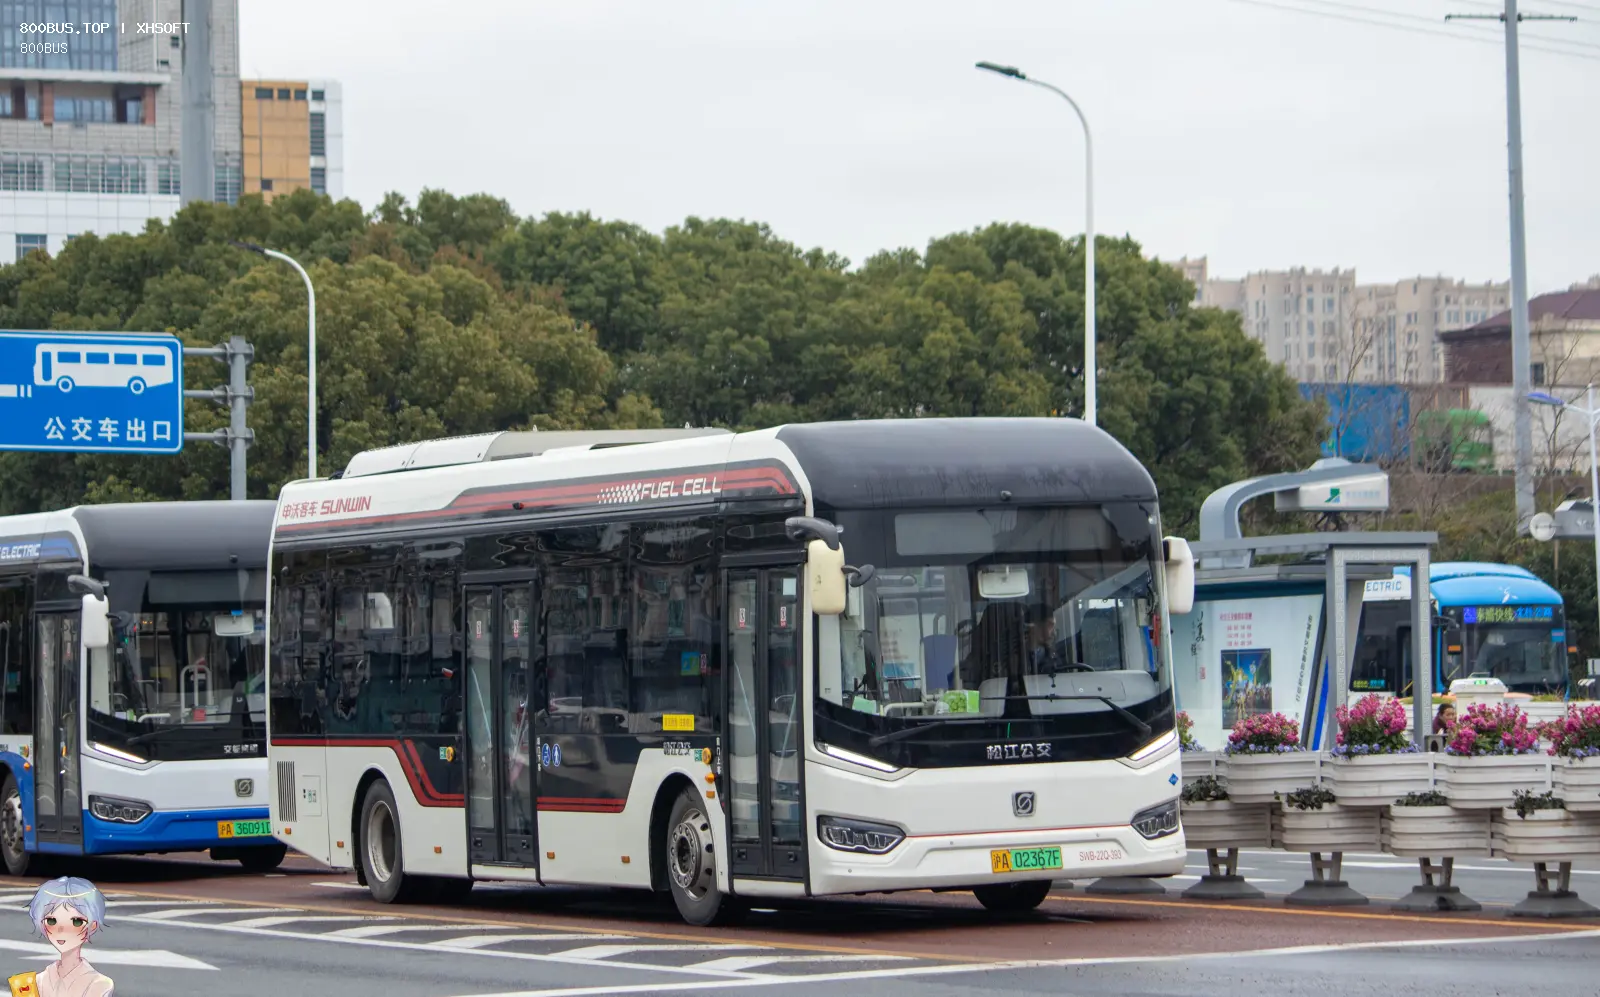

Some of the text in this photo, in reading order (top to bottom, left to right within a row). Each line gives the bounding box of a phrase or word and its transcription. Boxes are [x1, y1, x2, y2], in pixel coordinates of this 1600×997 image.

[44, 416, 171, 442] 公交车出口
[641, 476, 722, 500] FUEL CELL
[282, 495, 372, 519] 申沃客车 SUNWIN
[1, 543, 41, 559] ELECTRIC
[1365, 580, 1402, 592] ECTRIC
[986, 743, 1052, 760] 松江公交
[1014, 849, 1060, 868] 02367F
